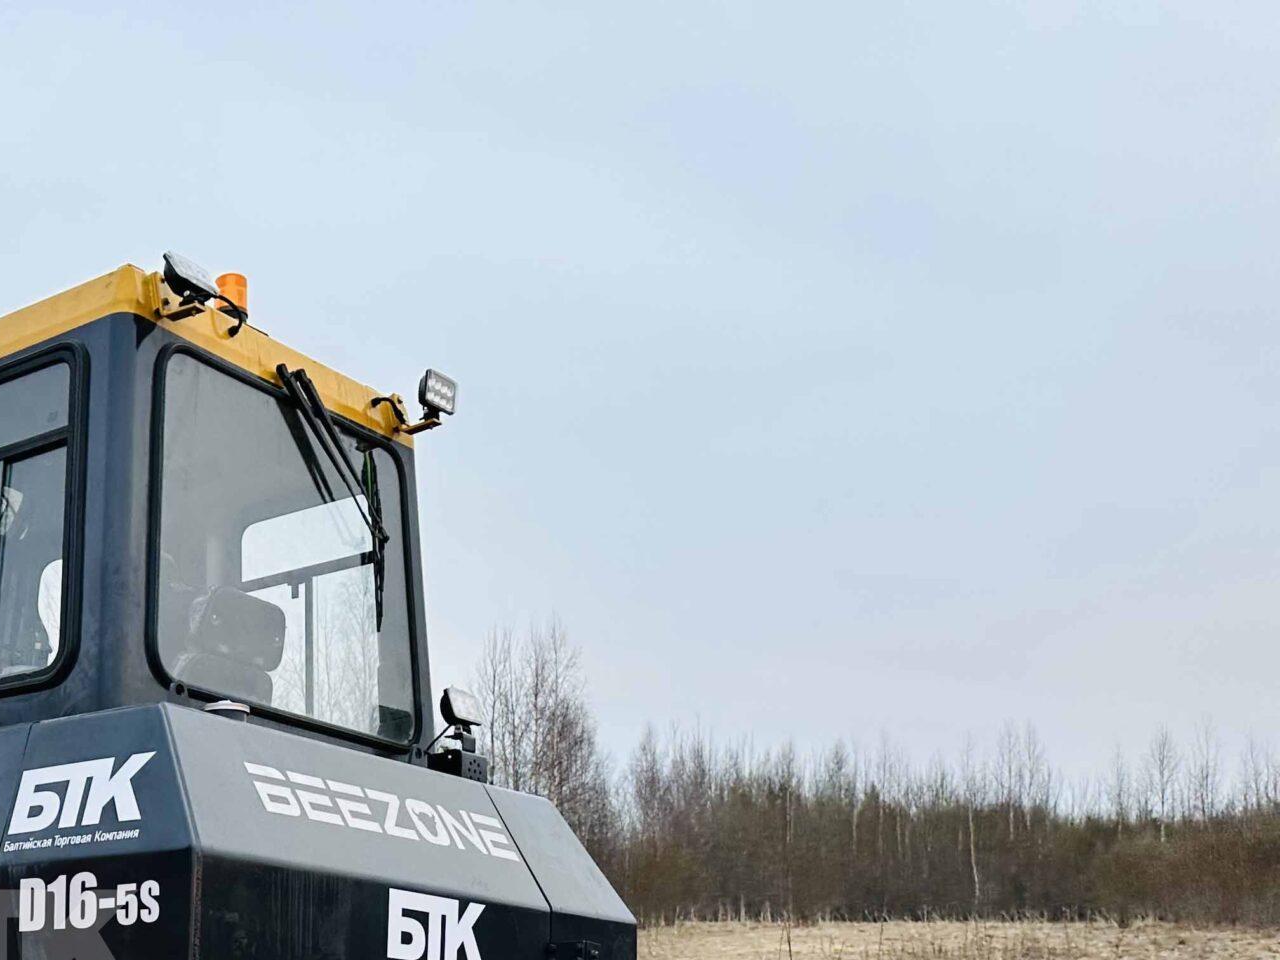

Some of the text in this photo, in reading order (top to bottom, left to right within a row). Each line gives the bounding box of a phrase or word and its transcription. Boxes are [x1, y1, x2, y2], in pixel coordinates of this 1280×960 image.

[8, 751, 158, 835] БТК
[243, 761, 520, 862] BEEZONE
[3, 828, 140, 853] Балтийская Торговая Компания
[18, 871, 161, 932] D16-5S
